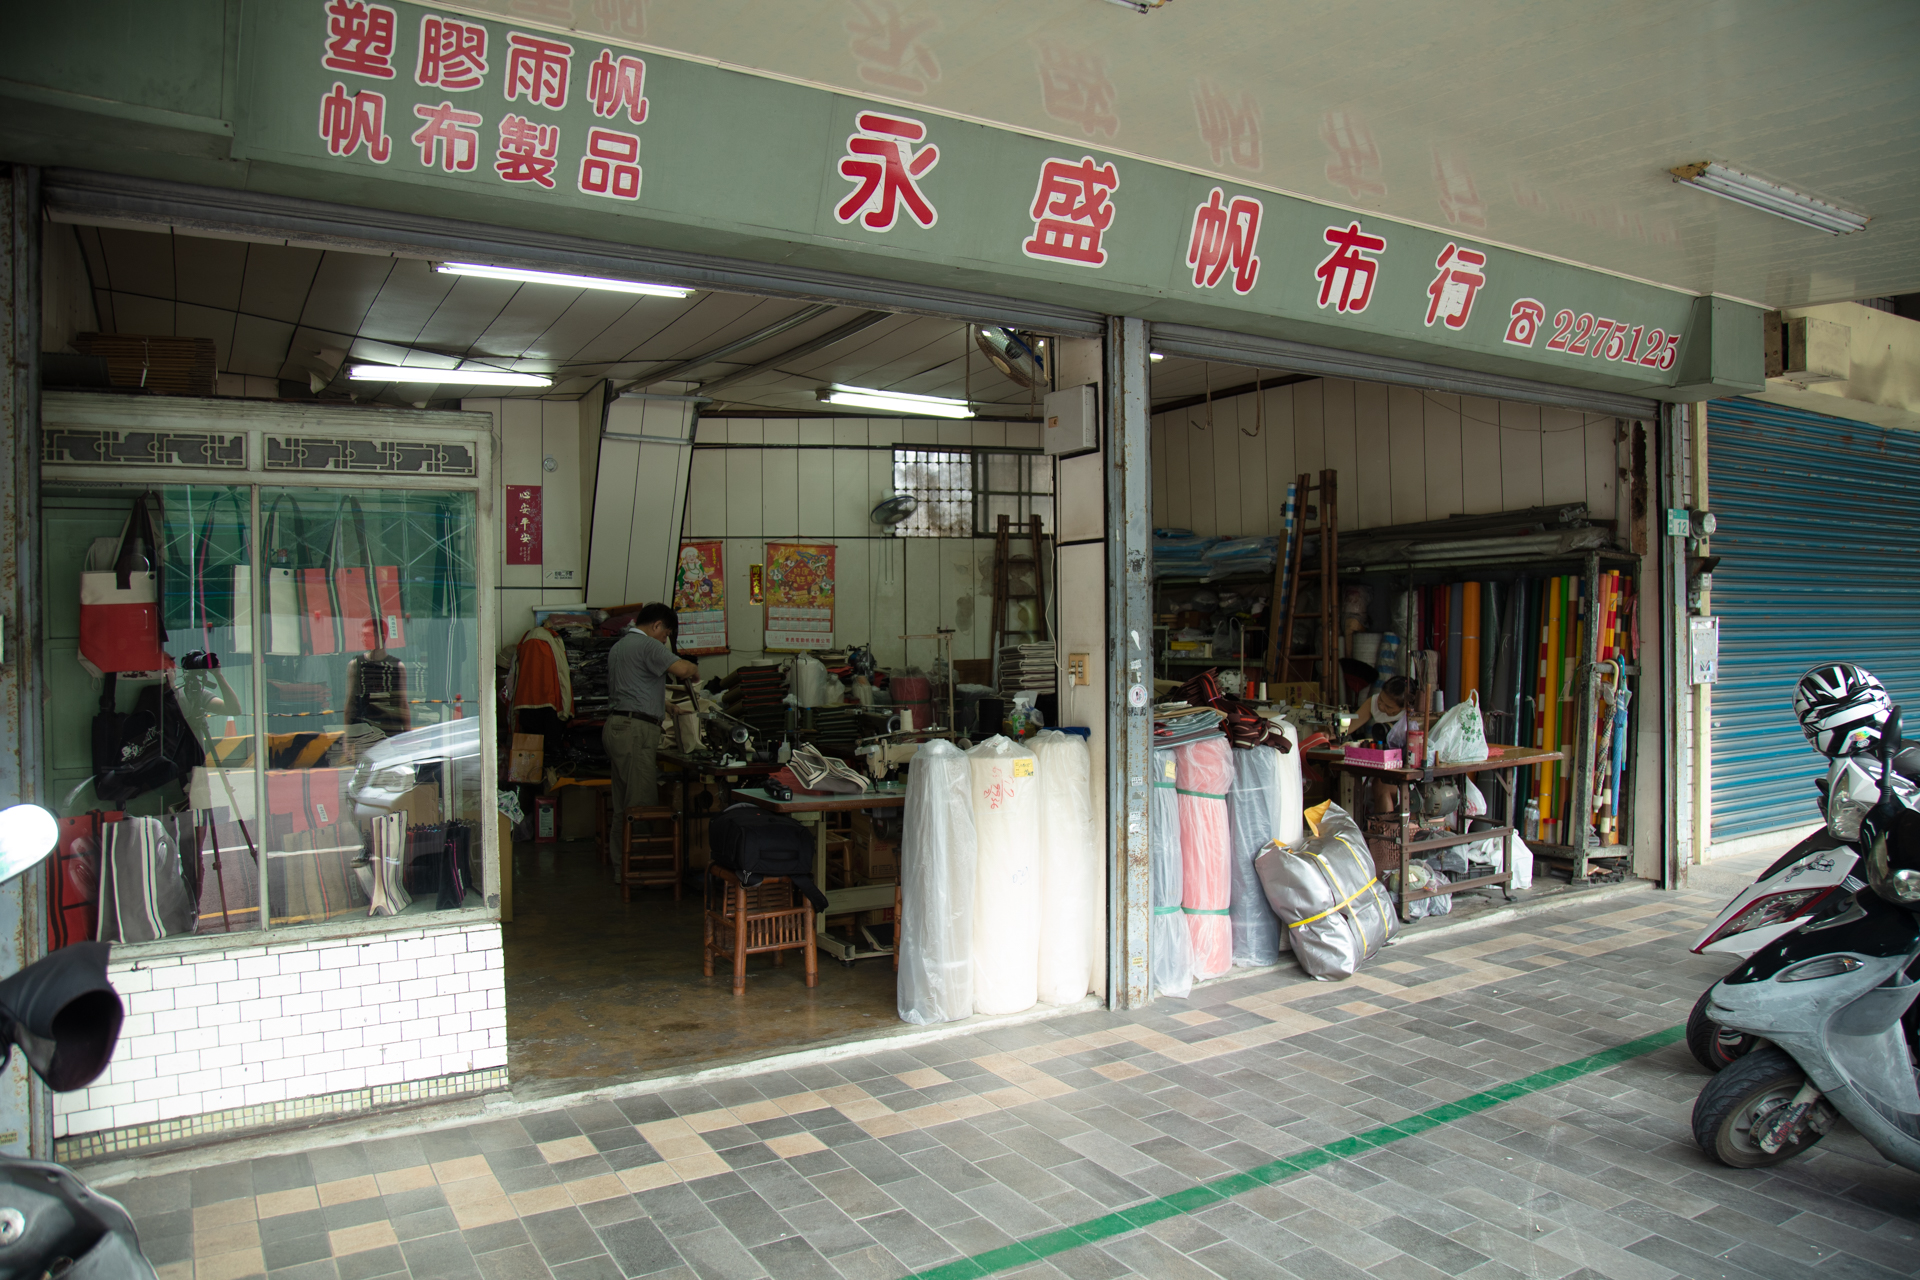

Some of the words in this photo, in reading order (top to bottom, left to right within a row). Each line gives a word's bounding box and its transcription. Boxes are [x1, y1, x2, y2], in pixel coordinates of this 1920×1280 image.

[323, 1, 648, 124] 塑膠雨帆
[320, 82, 640, 201] 帆布製品
[834, 110, 1487, 330] 永盛帆布行
[1546, 309, 1681, 371] 2275125
[1677, 521, 1687, 534] 12
